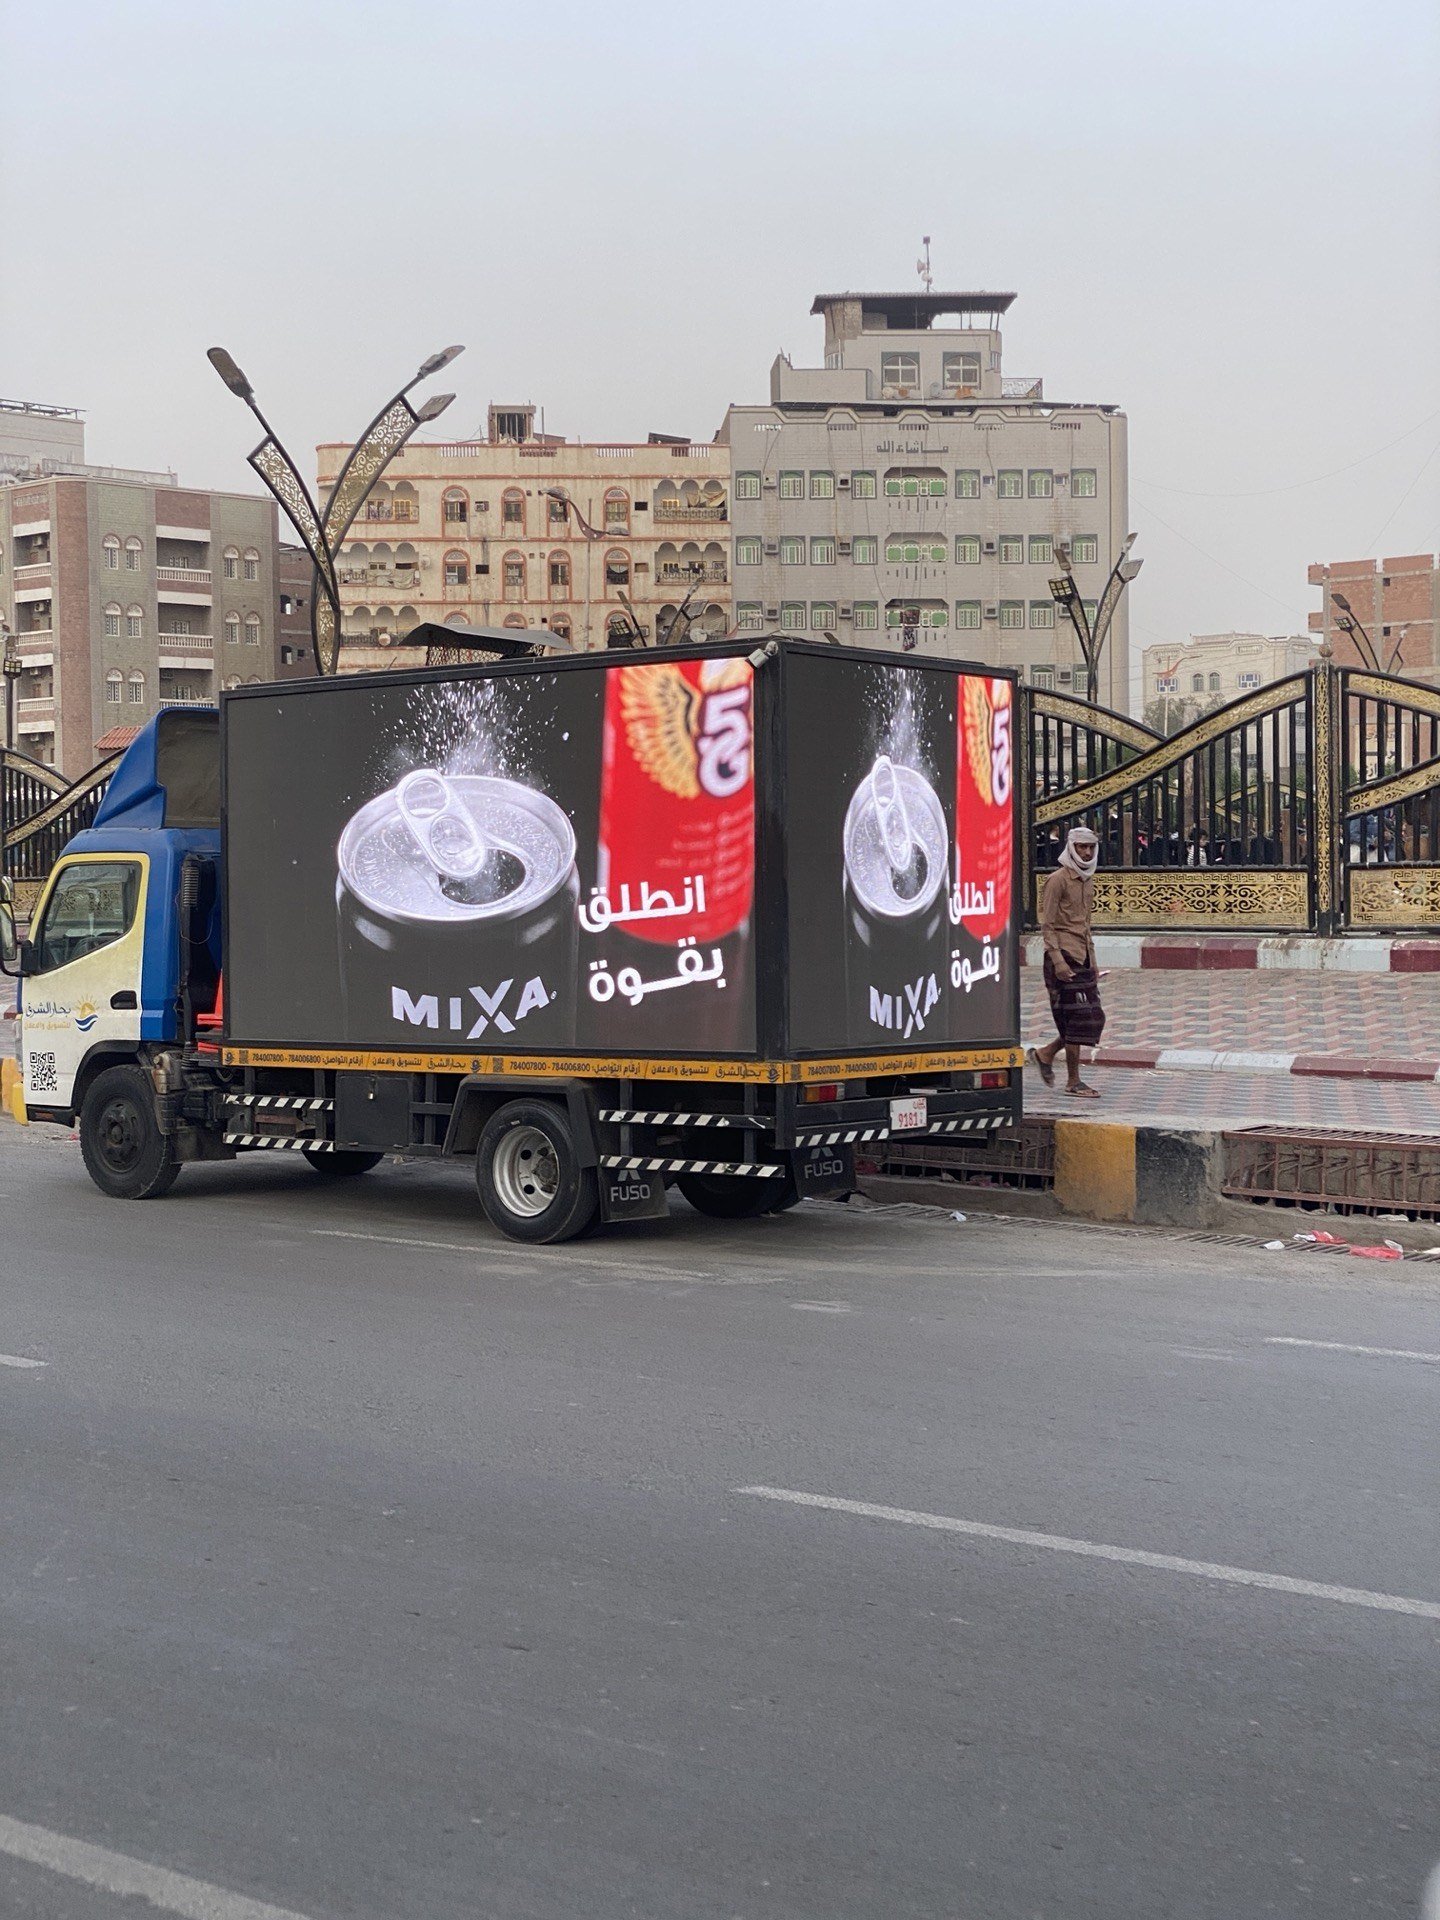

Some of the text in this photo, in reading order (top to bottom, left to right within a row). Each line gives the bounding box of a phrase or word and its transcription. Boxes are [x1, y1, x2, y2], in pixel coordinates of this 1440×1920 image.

[578, 874, 707, 934] انطلق
[949, 880, 995, 926] انطلق
[588, 935, 728, 1007] بقوة
[951, 935, 1001, 994] بقوة
[391, 975, 550, 1041] MIXA
[869, 973, 939, 1040] MIXA
[509, 1060, 547, 1071] 784007800
[551, 1061, 591, 1072] 784006800
[897, 1111, 919, 1128] 9181
[803, 1159, 844, 1180] FUSO
[610, 1184, 651, 1203] FUSO
